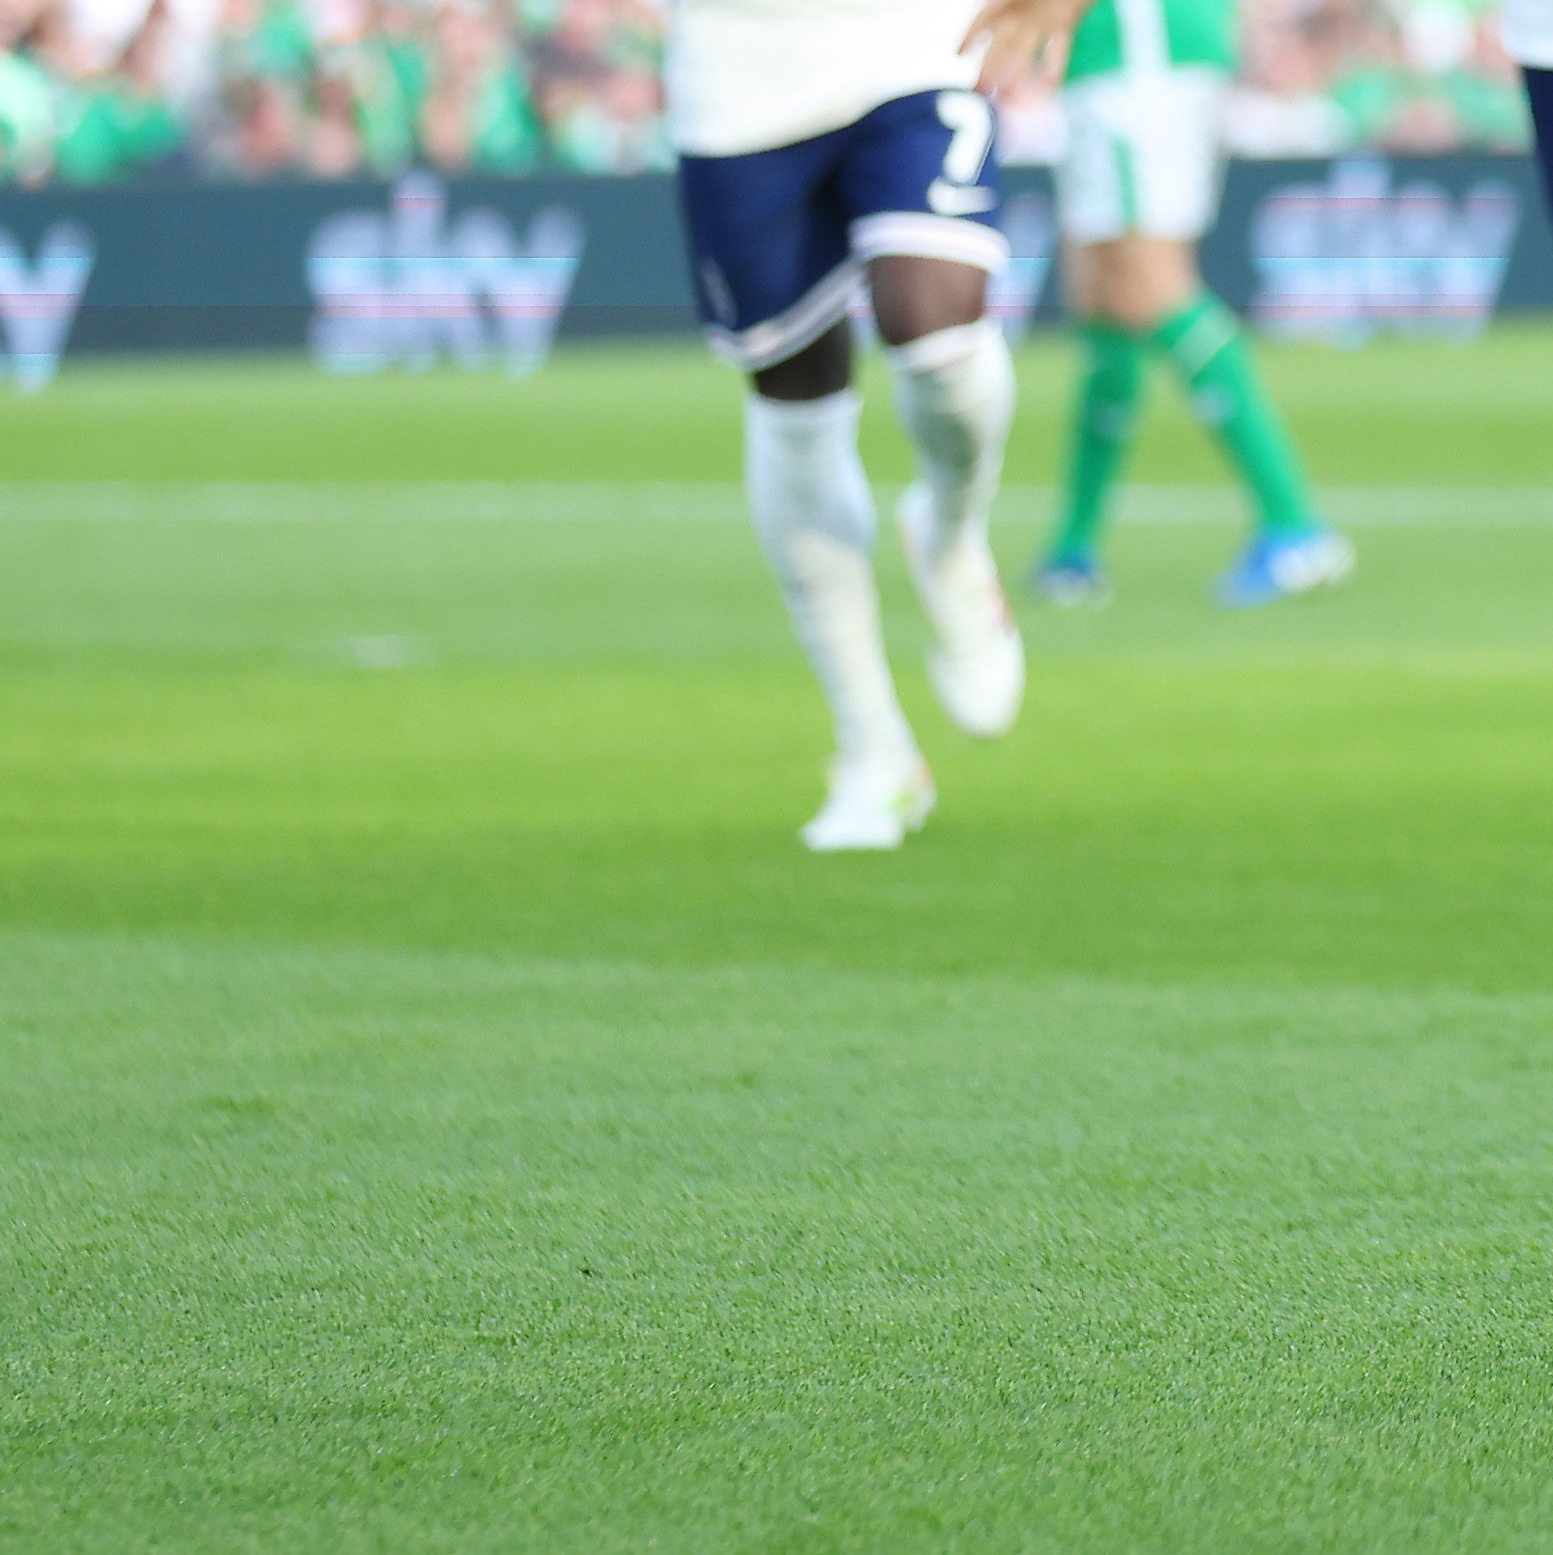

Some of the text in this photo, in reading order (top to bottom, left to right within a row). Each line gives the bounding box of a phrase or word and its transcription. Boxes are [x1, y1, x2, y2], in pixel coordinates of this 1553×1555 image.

[935, 91, 997, 184] 7
[306, 168, 584, 378] sky
[1253, 152, 1518, 351] sky
